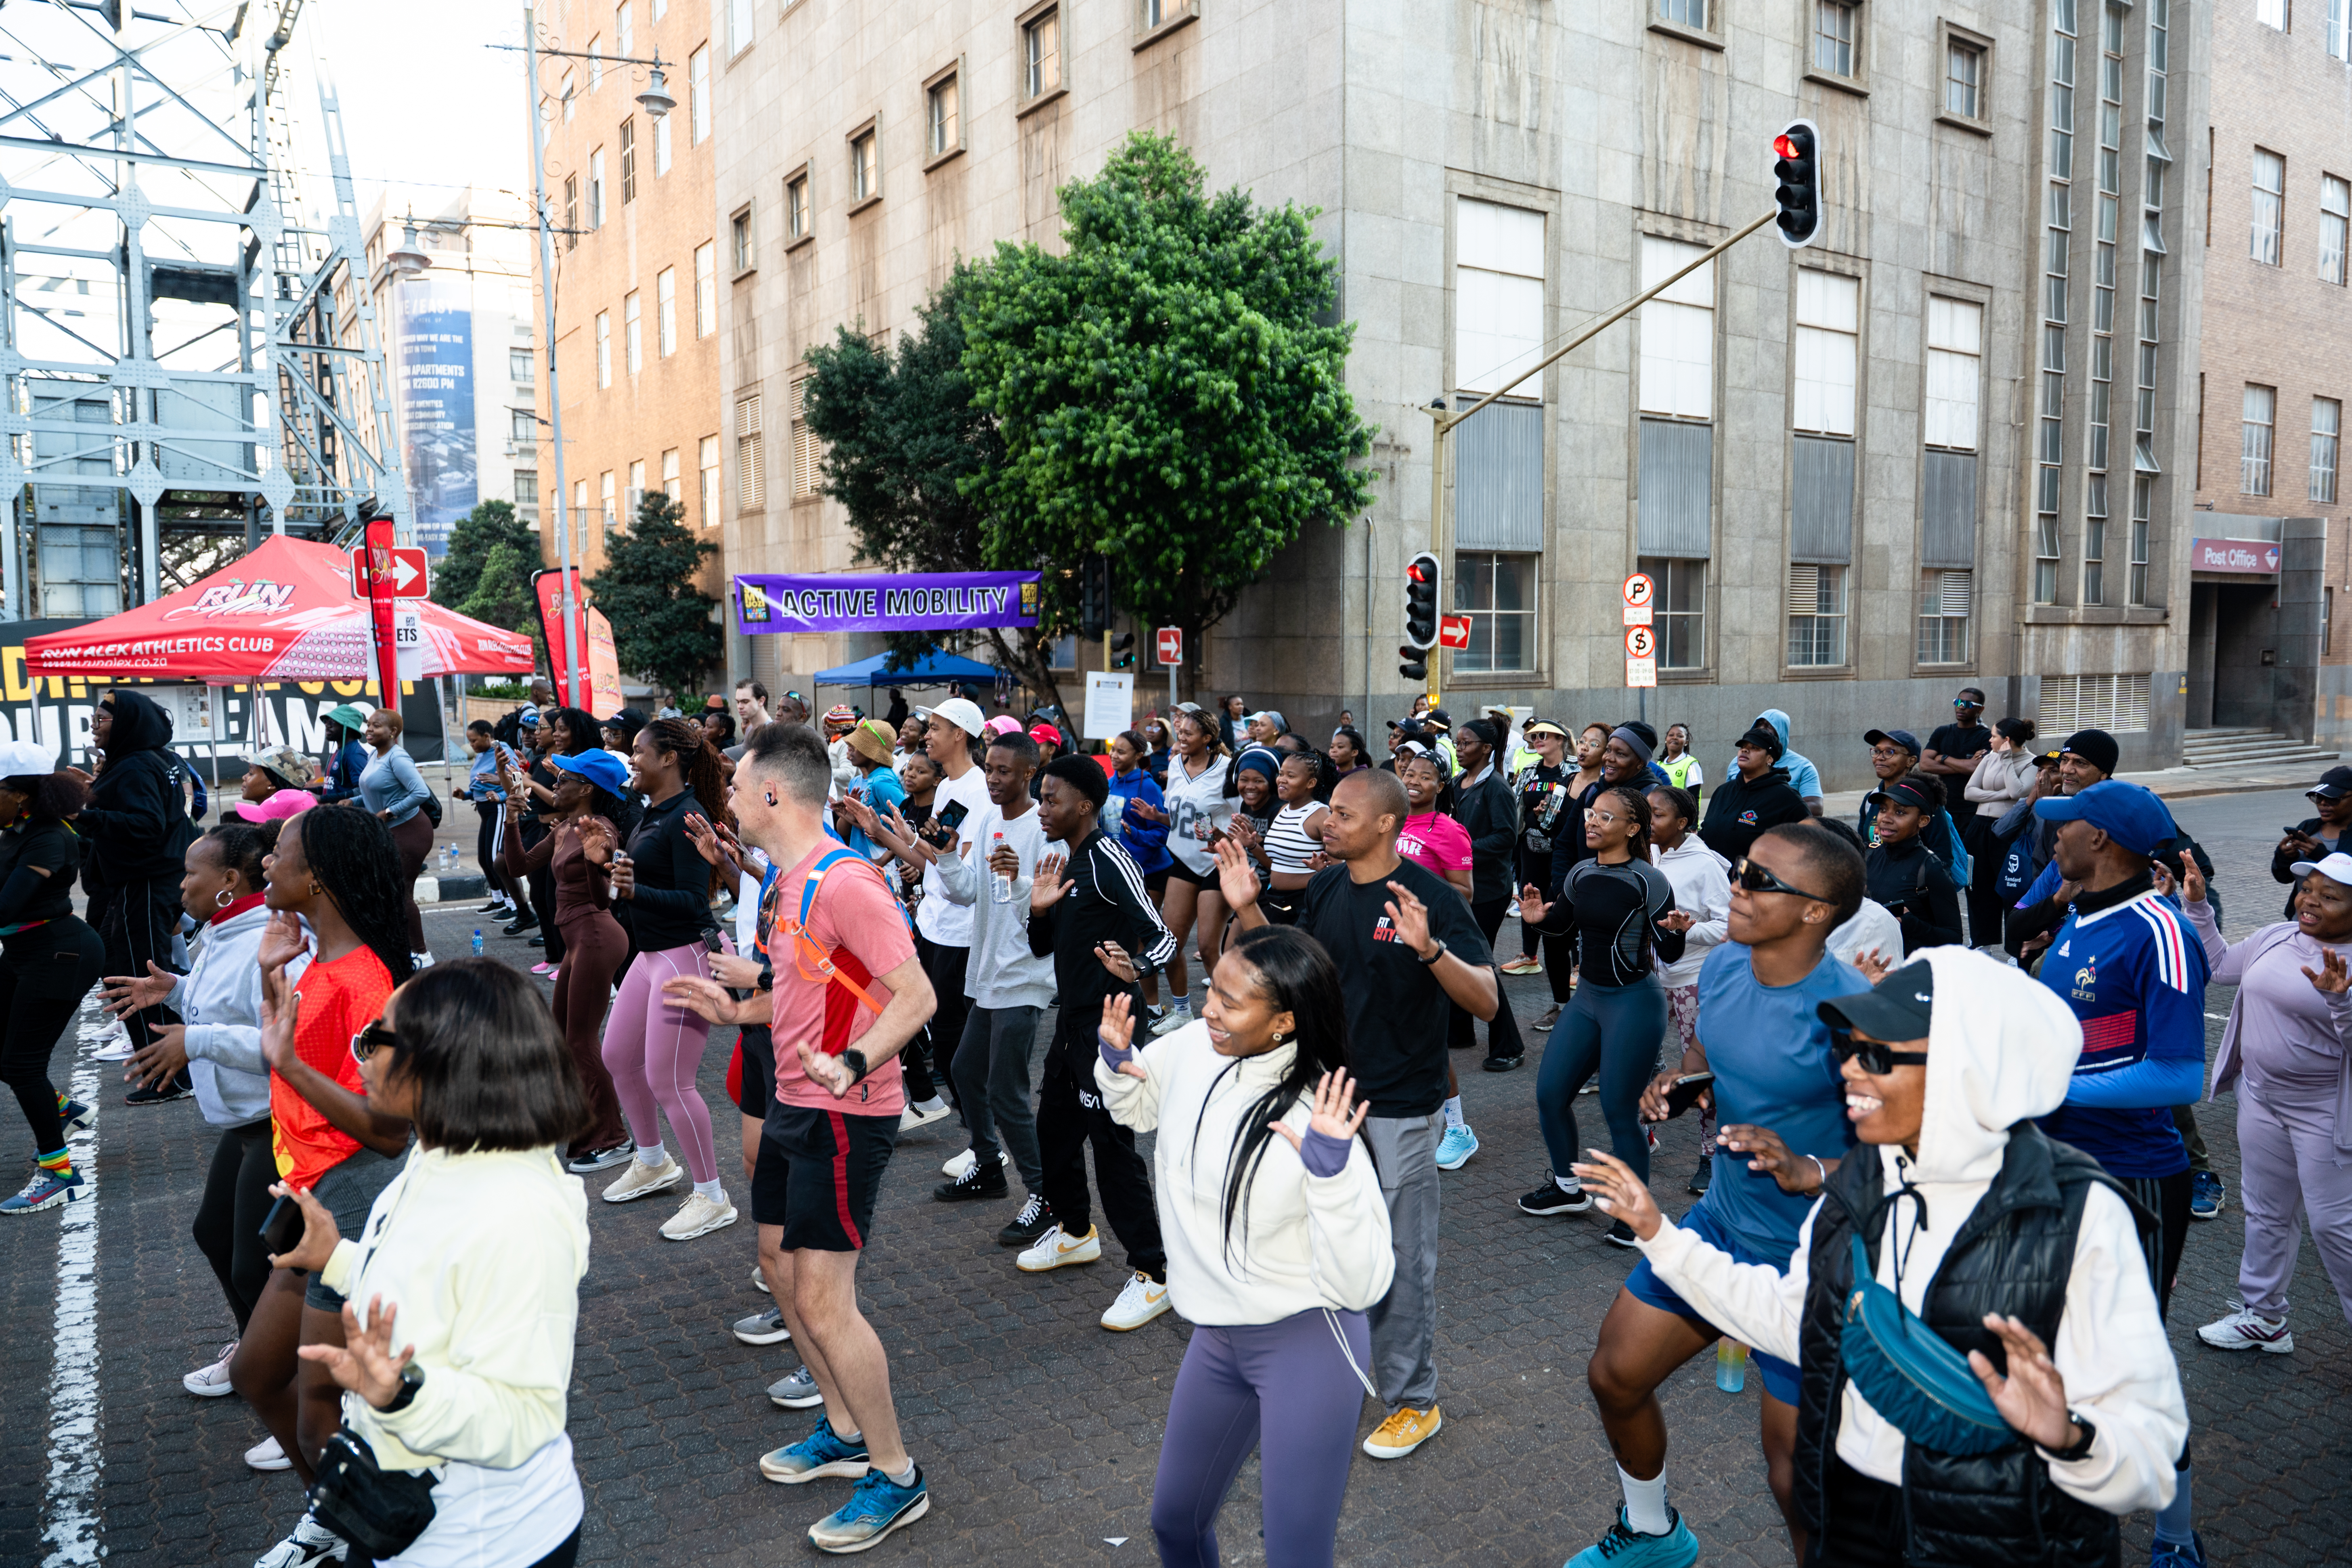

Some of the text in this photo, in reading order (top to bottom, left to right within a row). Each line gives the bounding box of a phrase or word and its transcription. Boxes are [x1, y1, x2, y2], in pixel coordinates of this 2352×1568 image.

[417, 334, 428, 342] WHY
[430, 334, 438, 342] WE
[440, 334, 451, 343] ARE
[452, 335, 463, 344] THE
[412, 364, 464, 376] APARTMENTS
[413, 377, 438, 389] R2600
[441, 378, 454, 389] PM
[416, 399, 443, 408] AMENITIES
[2205, 547, 2257, 568] Post Office
[194, 584, 297, 608] RUN
[1633, 583, 1645, 599] P
[782, 587, 1008, 617] ACTIVE MOBILITY
[41, 637, 274, 659] RUN ALEX ATHLETICS CLUB
[478, 639, 488, 651] RUN
[1635, 633, 1646, 650] S
[1377, 916, 1390, 929] FIT
[1373, 927, 1396, 942] CITY
